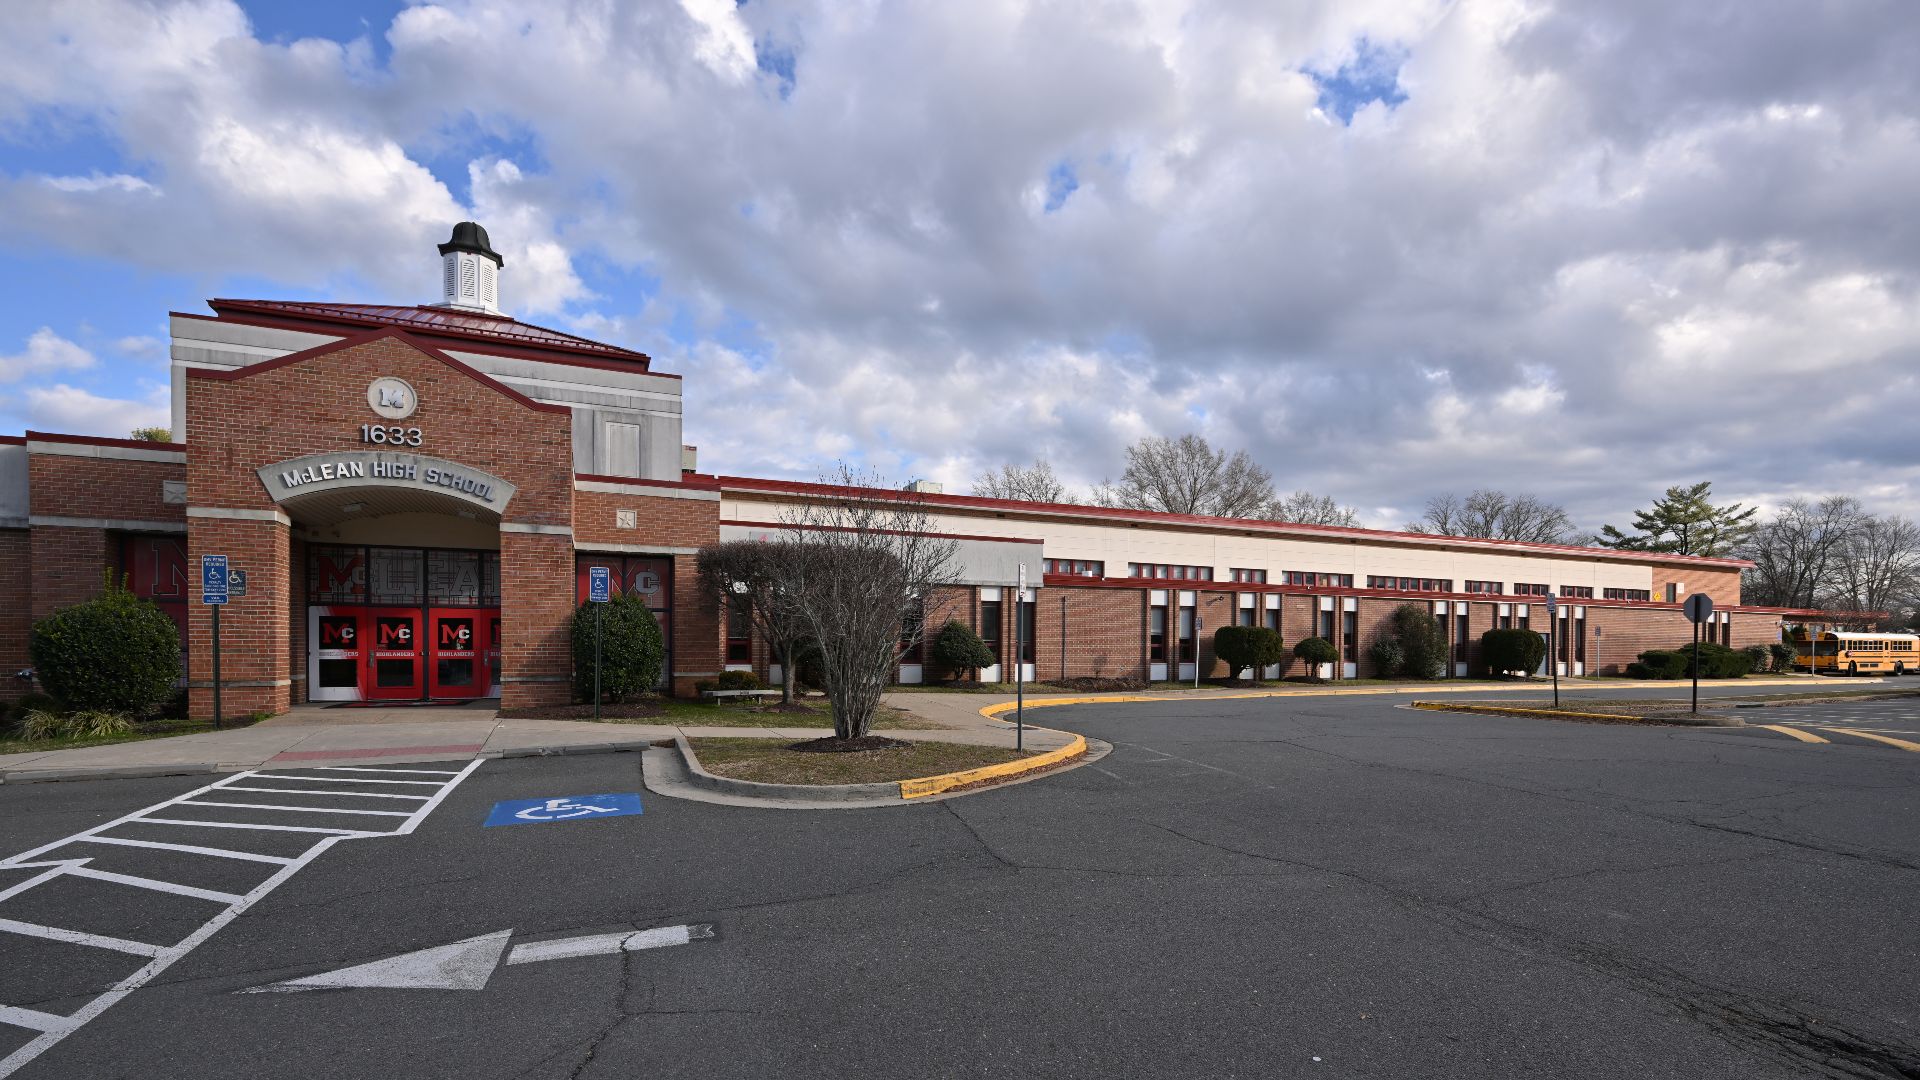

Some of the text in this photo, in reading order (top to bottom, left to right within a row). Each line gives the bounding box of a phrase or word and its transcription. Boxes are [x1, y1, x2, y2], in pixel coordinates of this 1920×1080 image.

[361, 424, 423, 446] 1633
[281, 461, 495, 501] McLEAN HIGH SCHOOL
